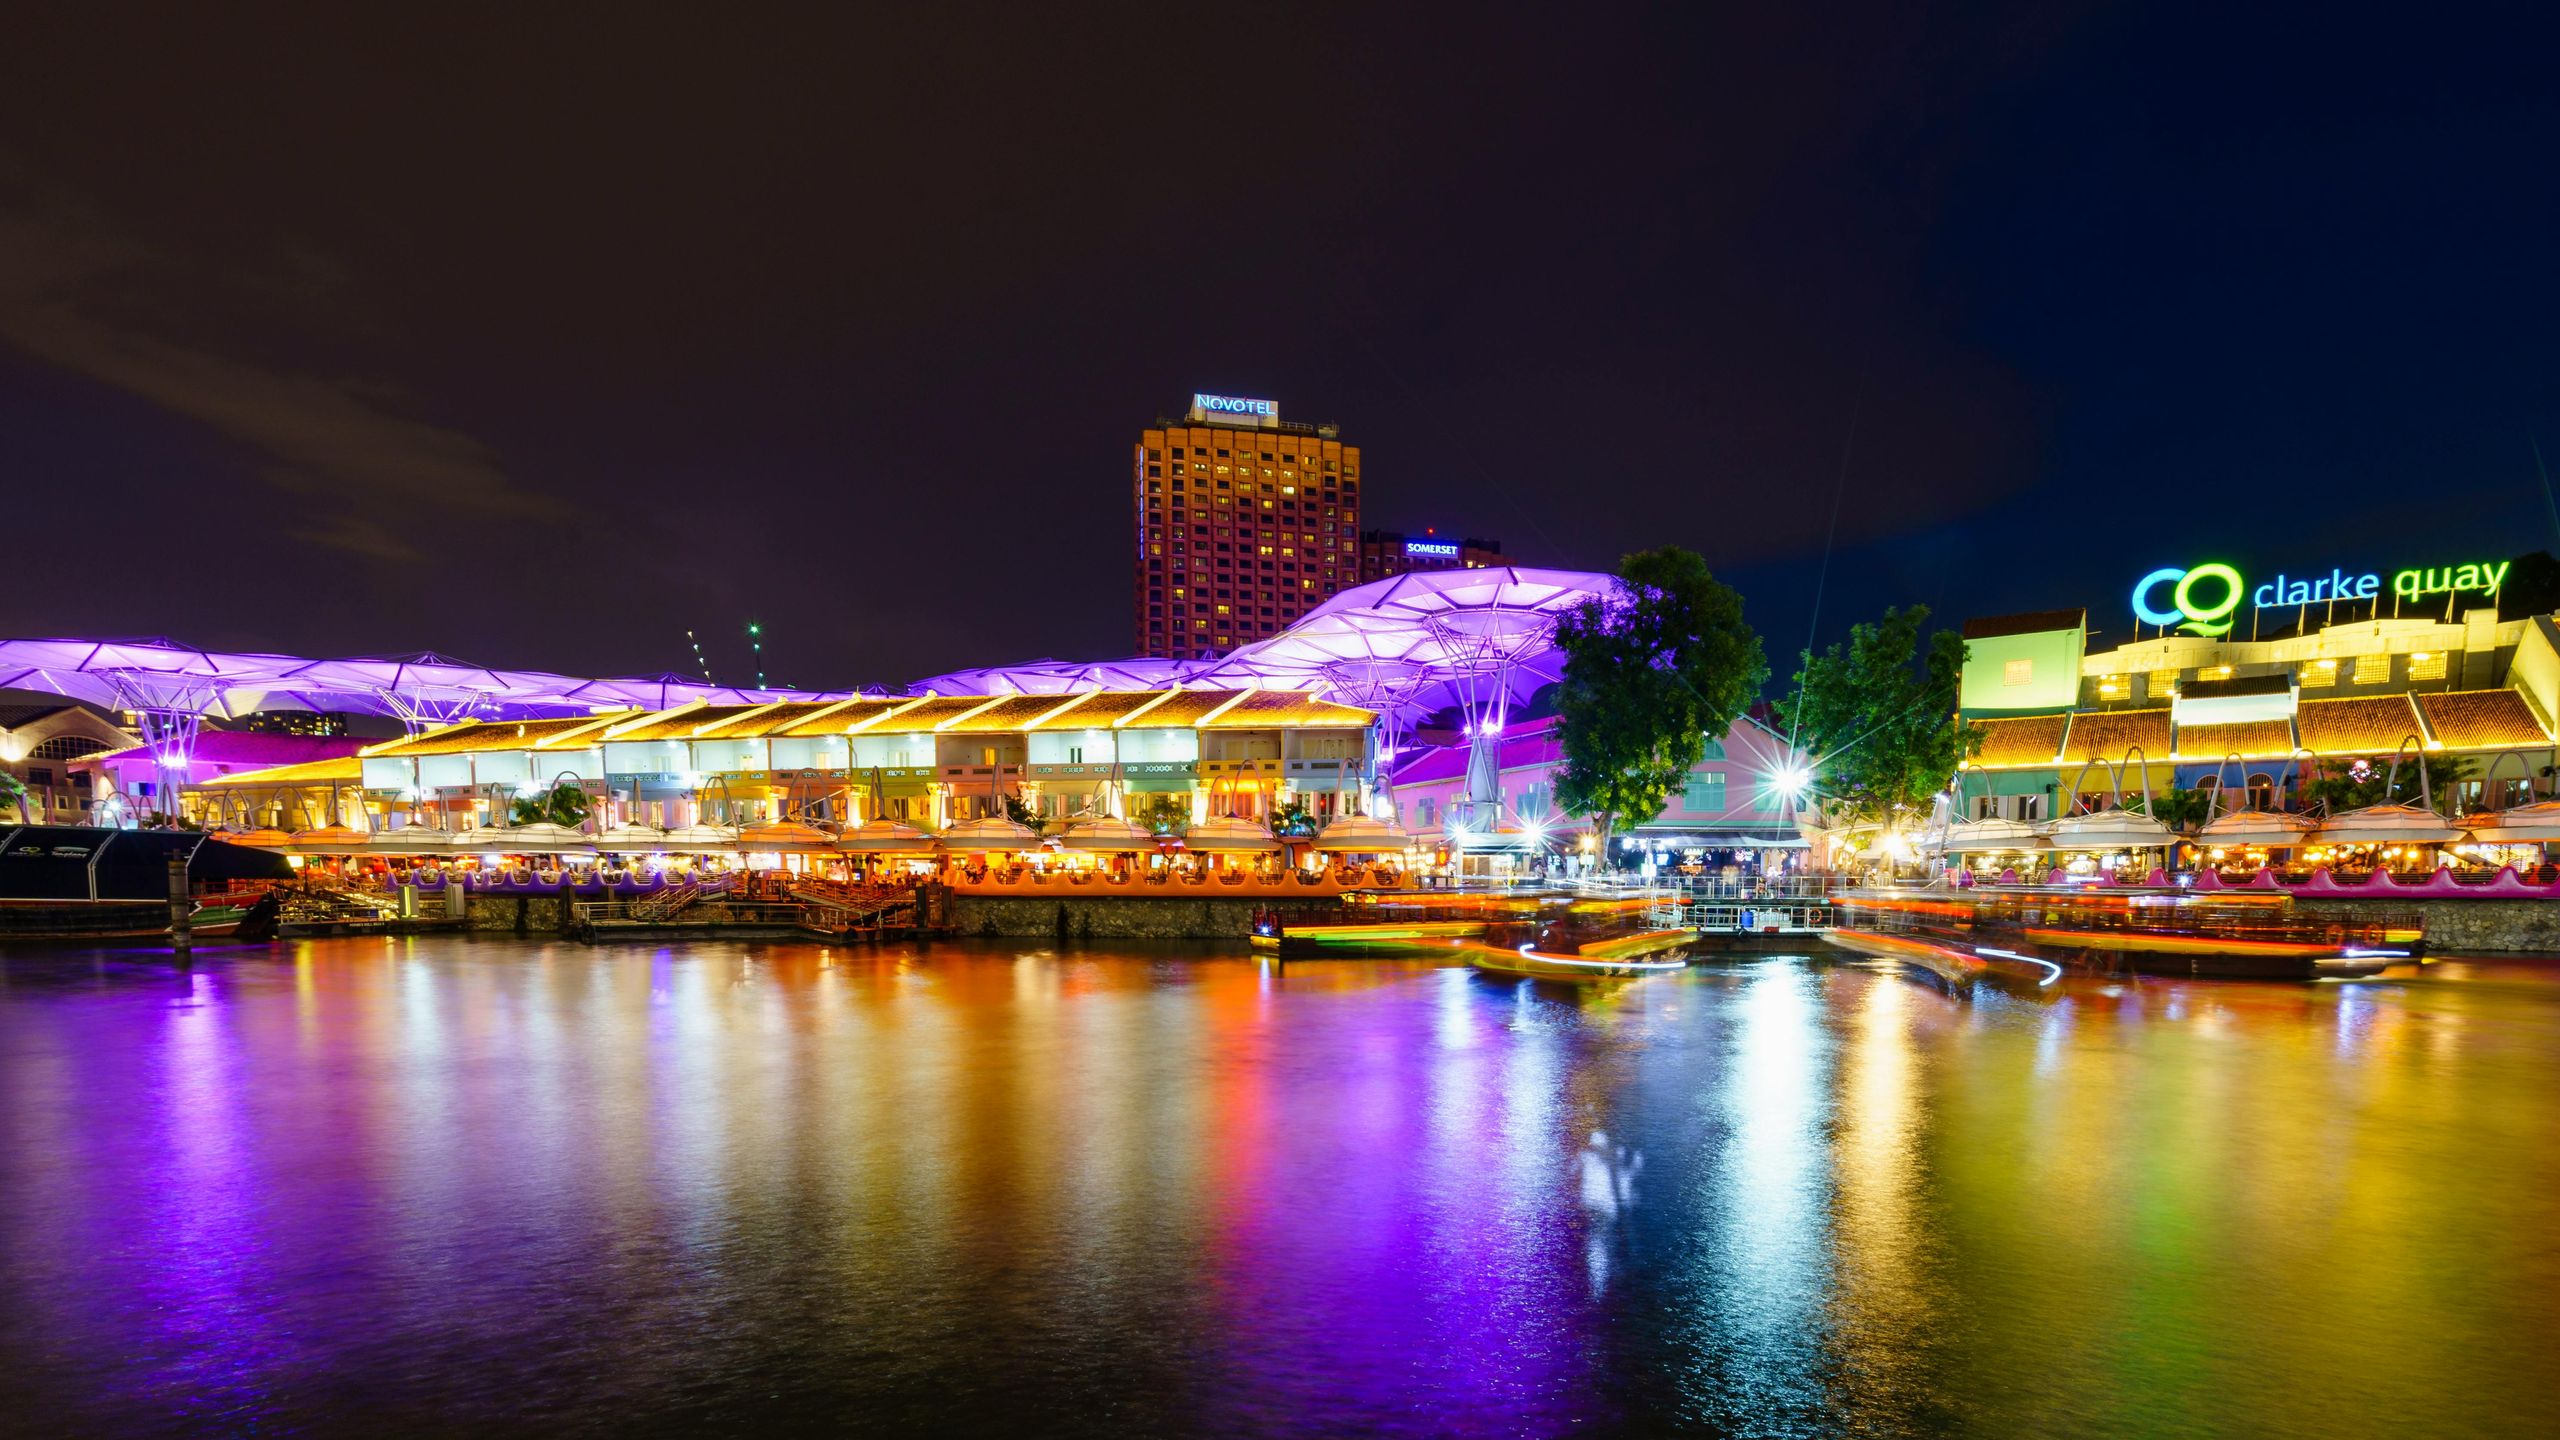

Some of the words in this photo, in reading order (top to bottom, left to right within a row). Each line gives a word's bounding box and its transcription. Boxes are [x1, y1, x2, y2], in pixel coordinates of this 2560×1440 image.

[1196, 394, 1276, 415] NOVOTEL
[1407, 543, 1459, 555] SOMERSET
[2254, 568, 2380, 608] clarke
[2394, 561, 2510, 603] quay
